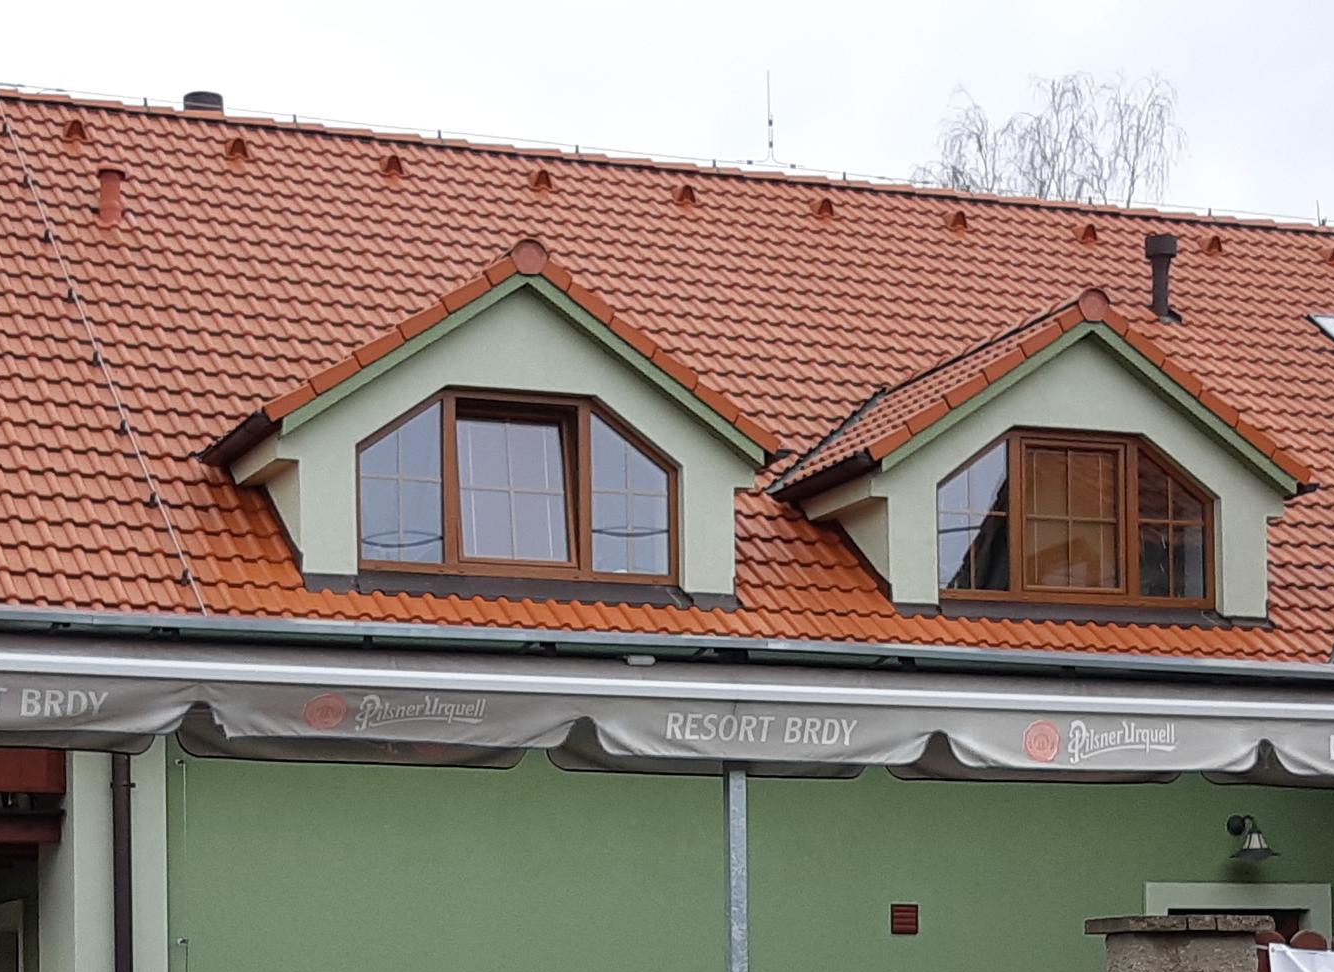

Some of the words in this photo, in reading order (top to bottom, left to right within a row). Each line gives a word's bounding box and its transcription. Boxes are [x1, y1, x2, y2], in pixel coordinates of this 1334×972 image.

[20, 688, 109, 718] BRDY
[355, 694, 426, 732] Pilsner
[425, 695, 486, 723] Urquell
[665, 712, 775, 742] RESORT
[784, 716, 858, 746] BRDY
[1068, 719, 1124, 764] Pilsner
[1122, 720, 1176, 752] Urquell
